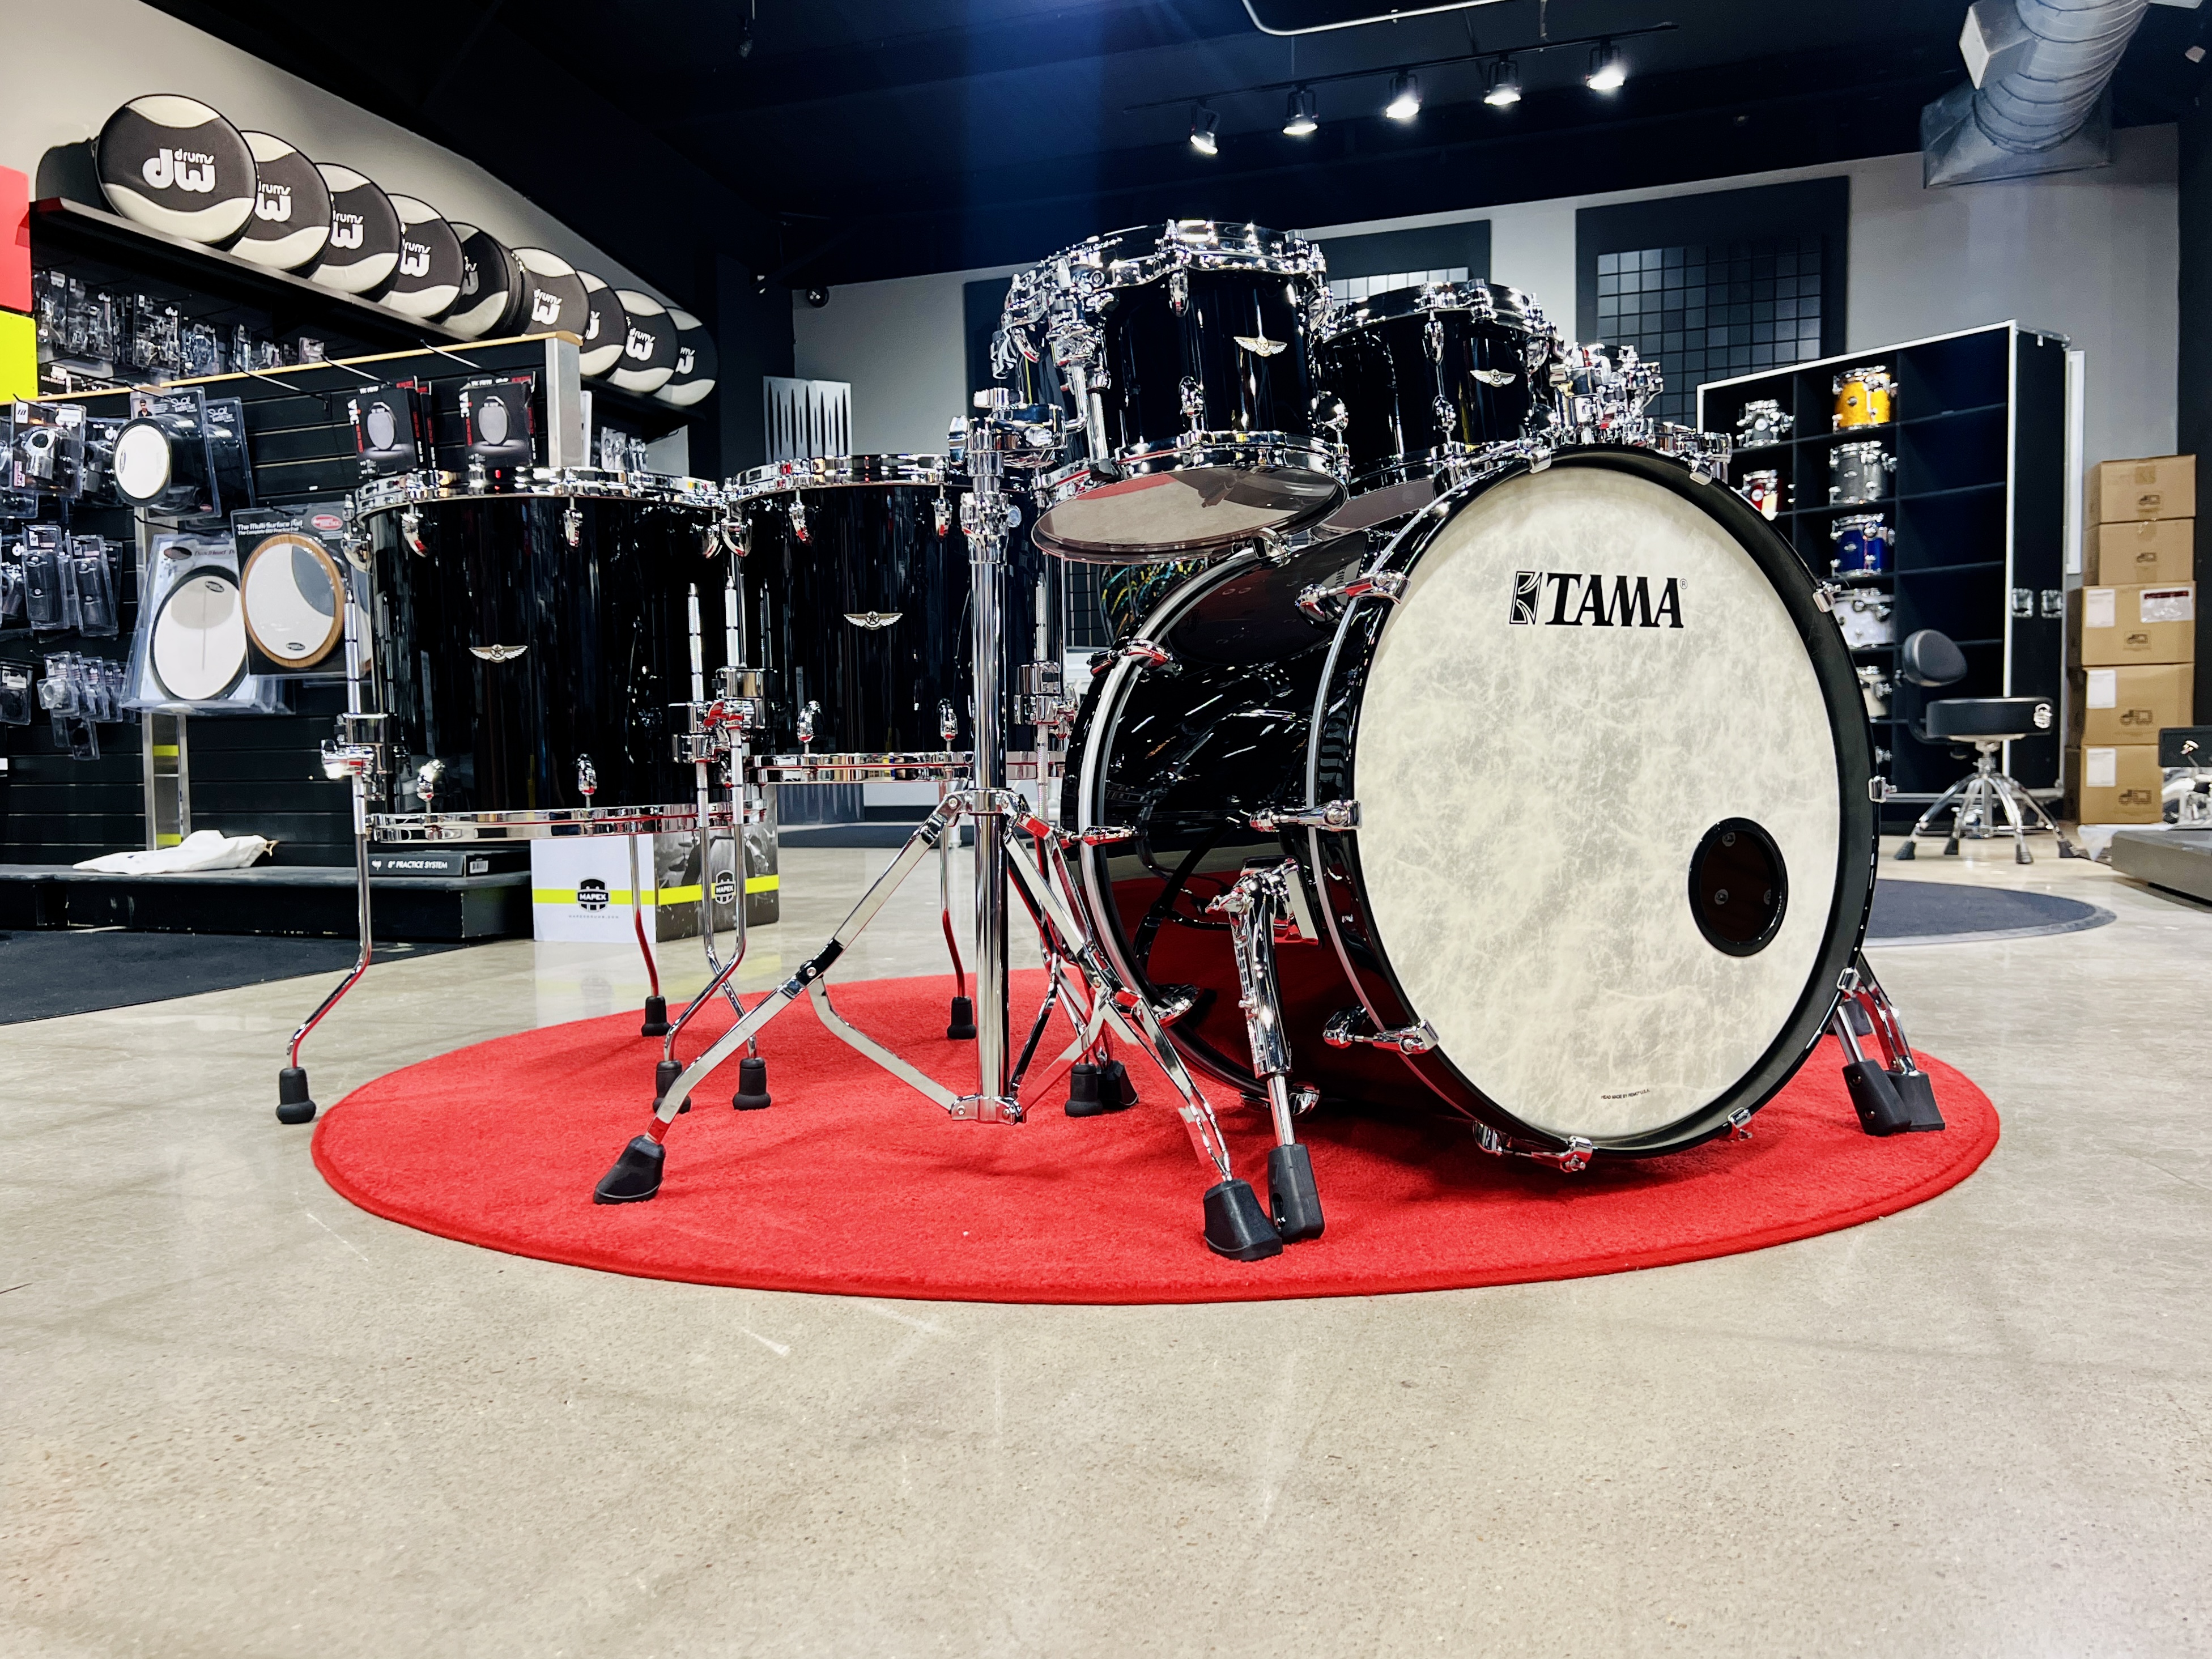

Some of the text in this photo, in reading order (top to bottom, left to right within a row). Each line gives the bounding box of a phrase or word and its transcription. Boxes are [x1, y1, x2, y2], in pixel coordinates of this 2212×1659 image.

[174, 148, 214, 163] drums
[629, 327, 656, 342] drums
[1545, 572, 1684, 628] TAMA
[397, 860, 424, 869] PRACTICE
[425, 861, 448, 869] SYSTEM
